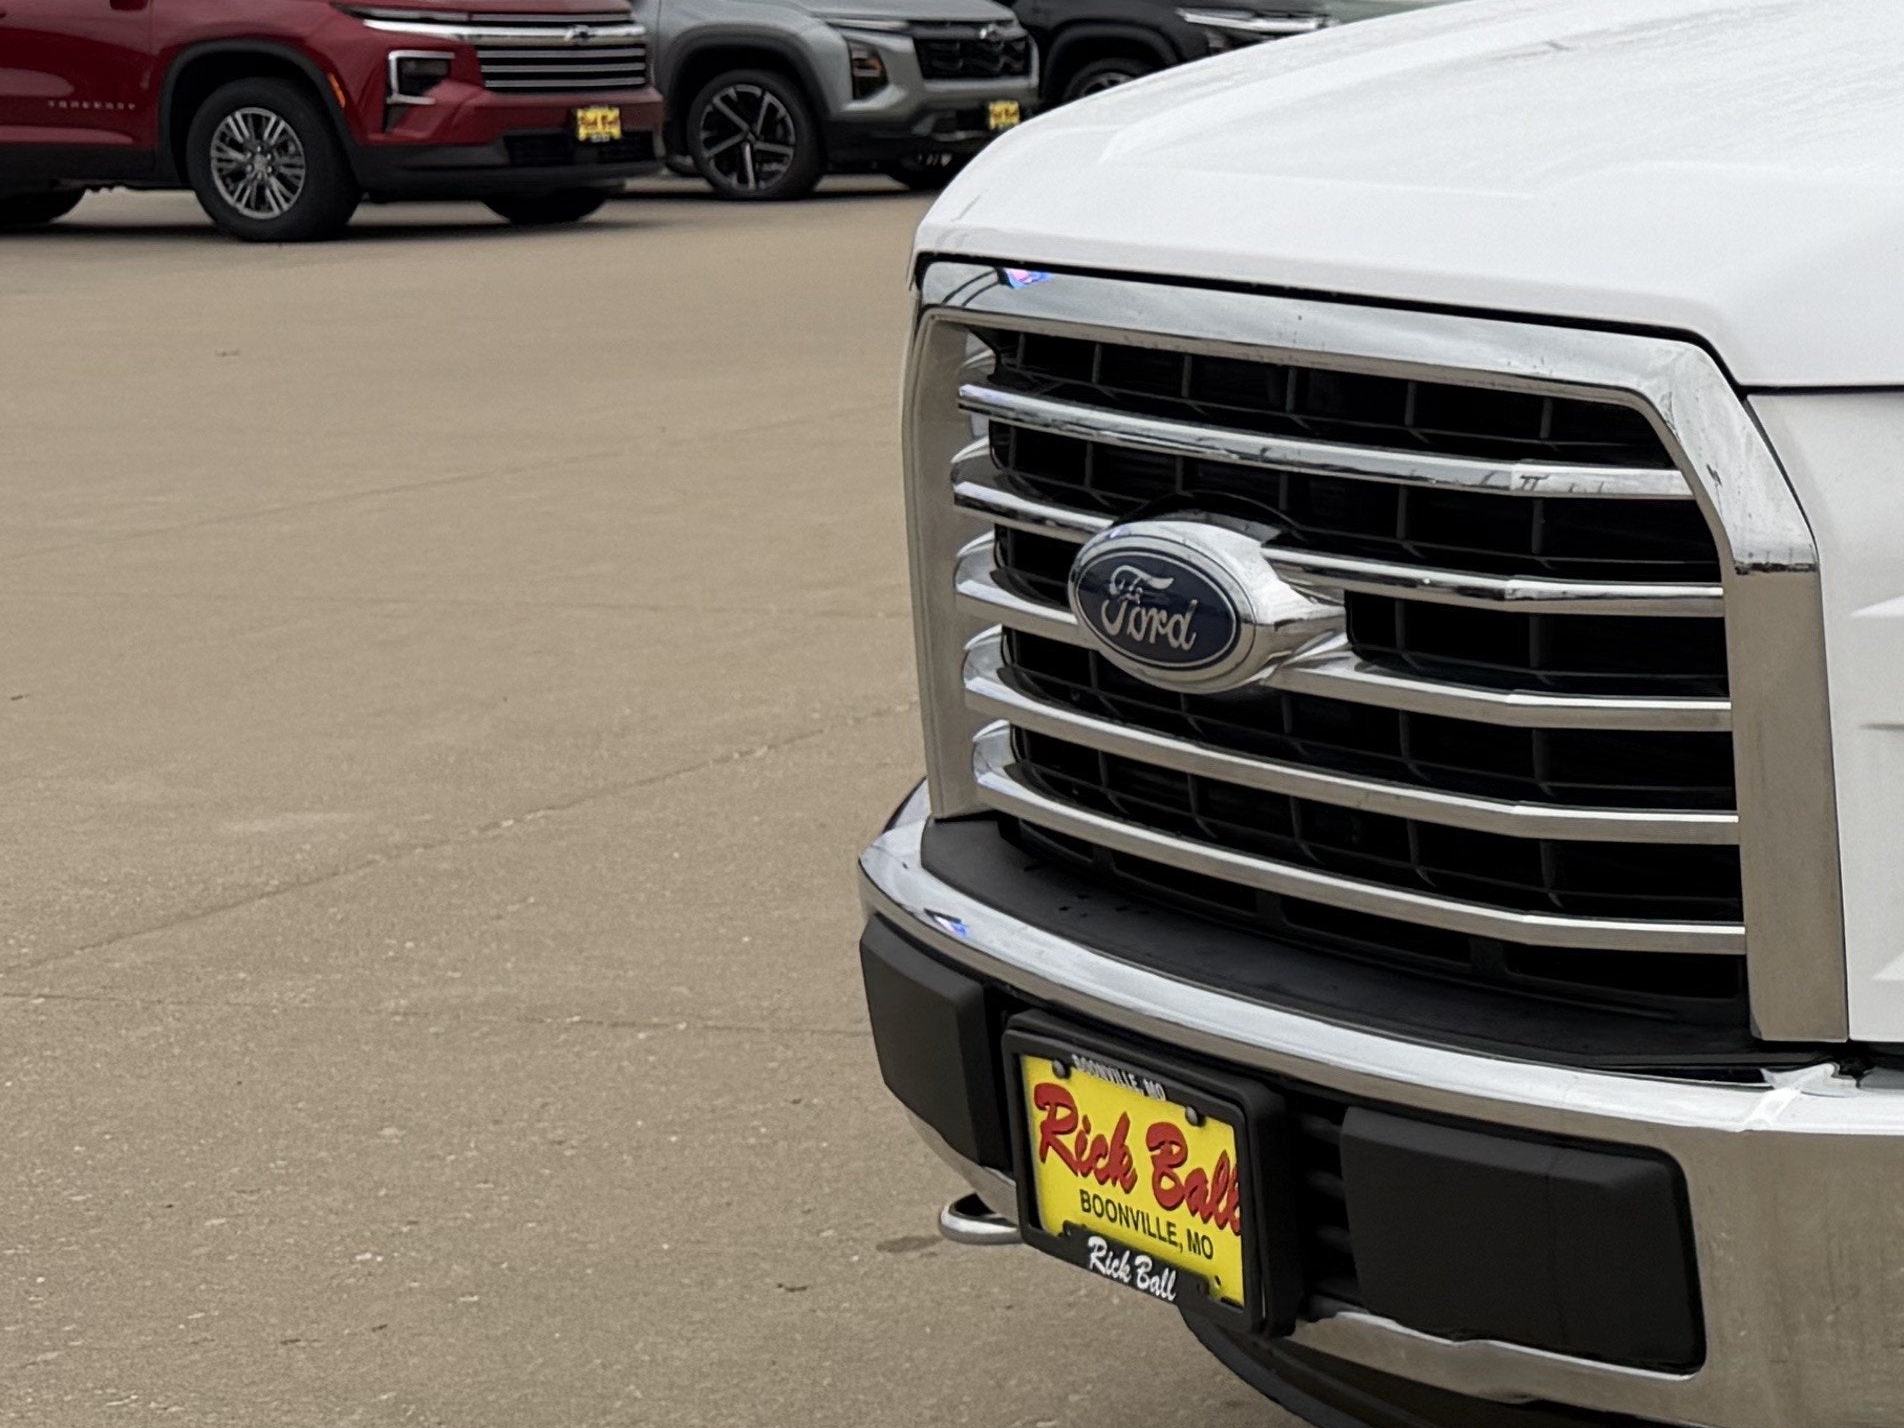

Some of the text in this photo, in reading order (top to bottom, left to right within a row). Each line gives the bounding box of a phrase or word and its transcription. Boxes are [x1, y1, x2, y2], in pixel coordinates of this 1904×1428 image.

[1101, 564, 1199, 652] Ford
[1034, 1082, 1241, 1236] Rick Ball
[1079, 1189, 1214, 1260] BOONVILLE, MO
[1087, 1235, 1177, 1301] Rick Ball
